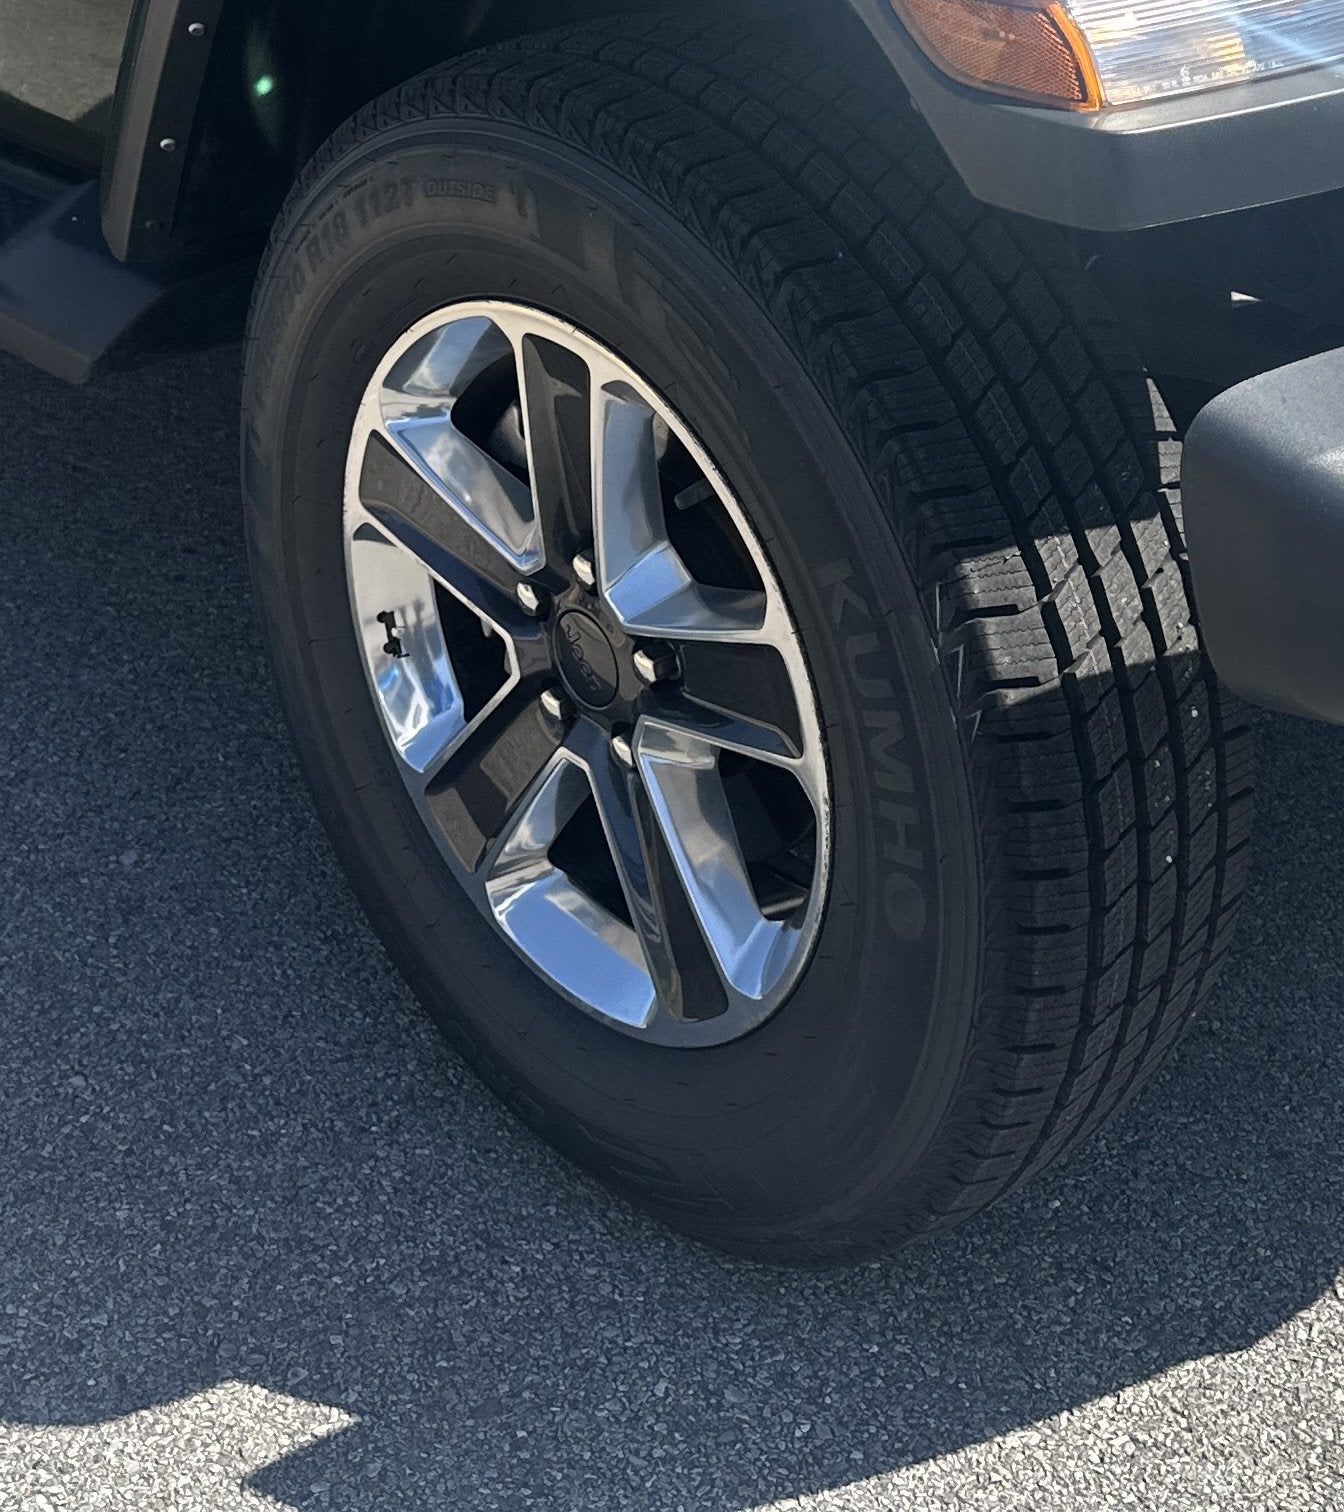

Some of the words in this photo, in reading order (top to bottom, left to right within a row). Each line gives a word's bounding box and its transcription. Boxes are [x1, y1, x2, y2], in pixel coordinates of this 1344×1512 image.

[425, 179, 497, 204] OUTSIDE
[565, 623, 603, 692] Jeep
[814, 557, 928, 942] KUMHO
